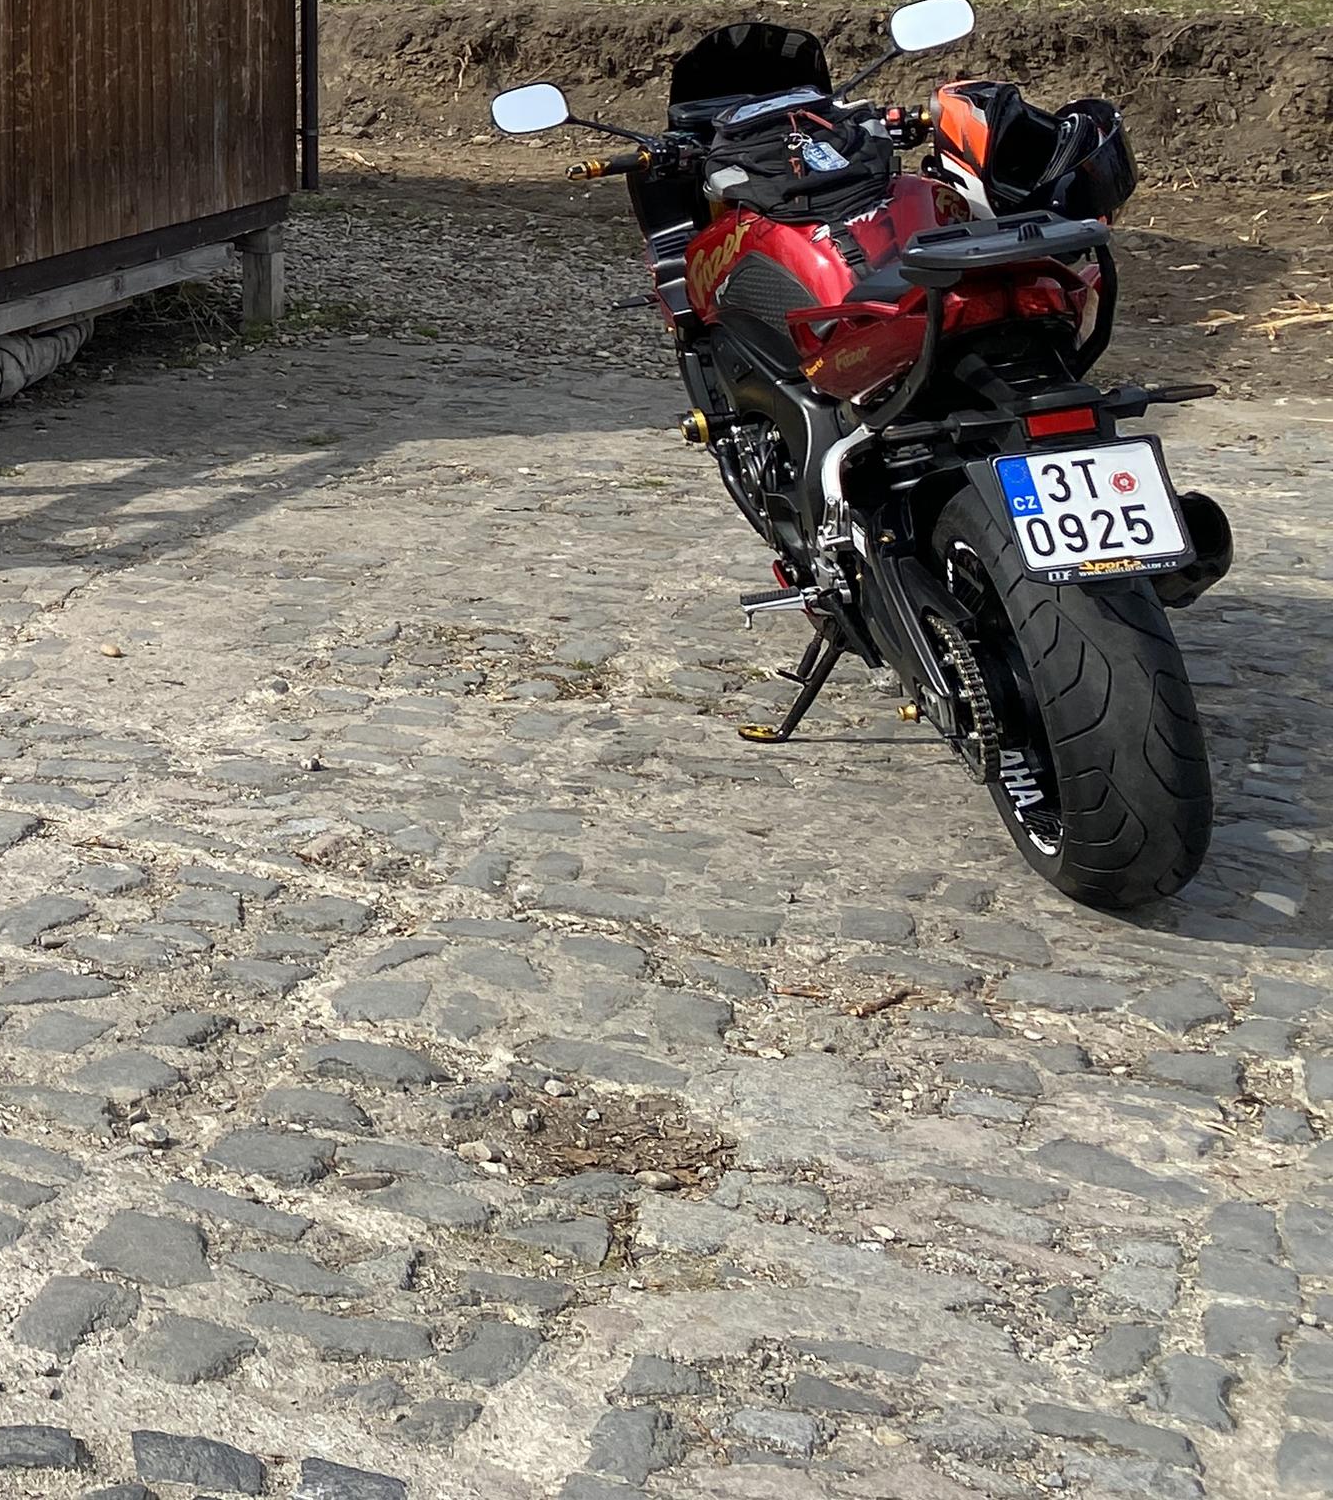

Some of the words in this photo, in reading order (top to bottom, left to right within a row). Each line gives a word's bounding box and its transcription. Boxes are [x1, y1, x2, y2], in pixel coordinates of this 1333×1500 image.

[690, 224, 751, 310] Fazer
[1013, 497, 1038, 511] CZ
[1041, 458, 1099, 503] 3T
[1026, 504, 1154, 557] 0925
[999, 749, 1045, 808] AHA
